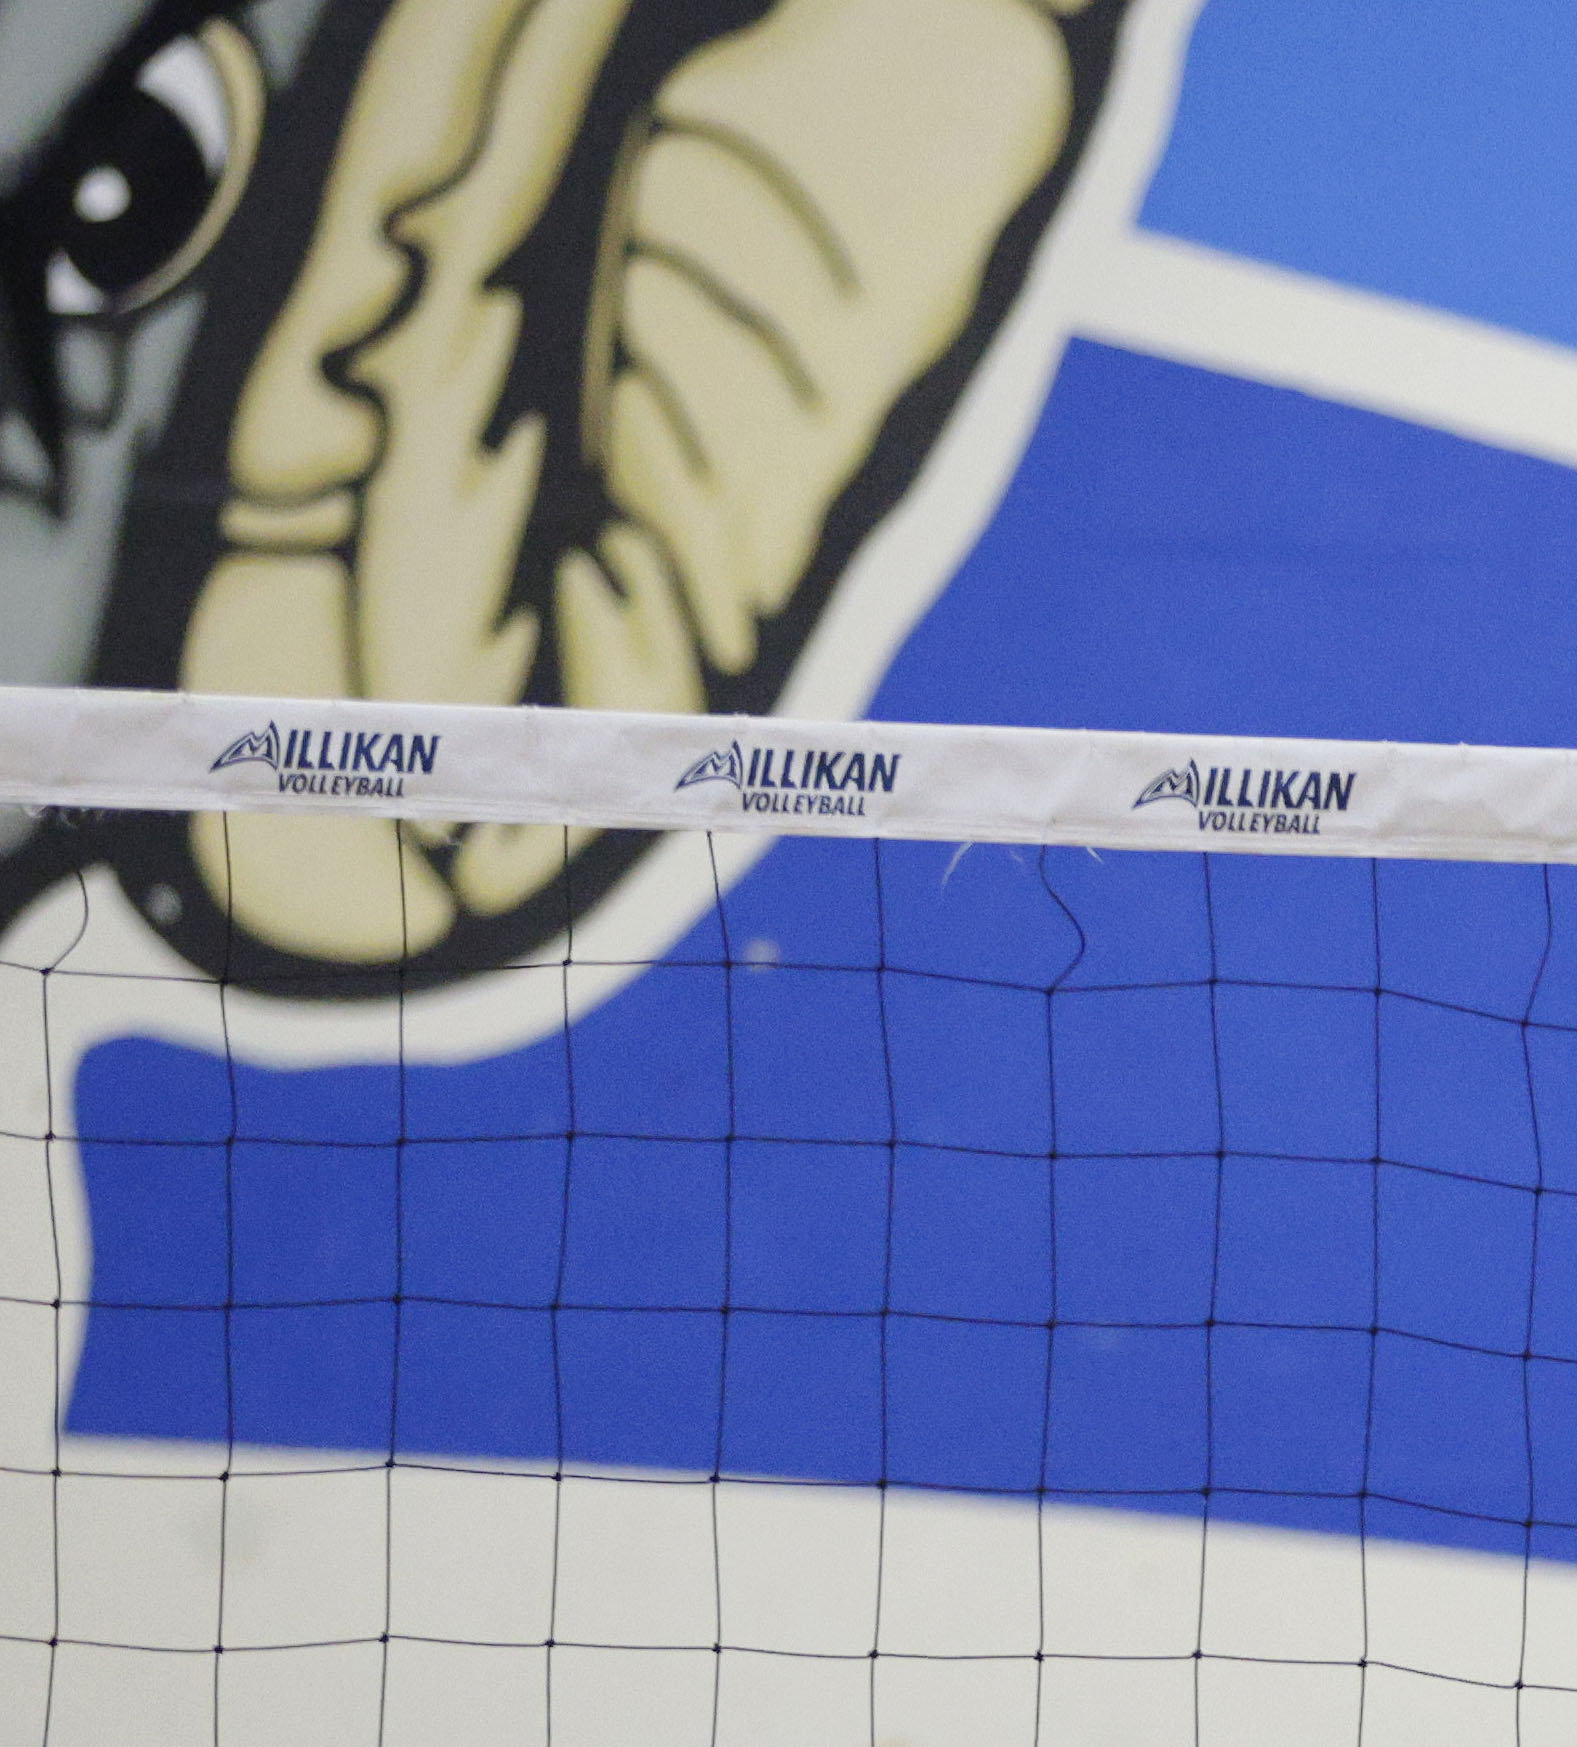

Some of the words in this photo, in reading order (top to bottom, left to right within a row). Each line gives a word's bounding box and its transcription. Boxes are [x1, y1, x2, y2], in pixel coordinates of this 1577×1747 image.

[279, 773, 405, 798] VOLLEYBALL
[742, 792, 867, 817] VOLLEYBALL
[1199, 811, 1322, 835] VOLLEYBALL
